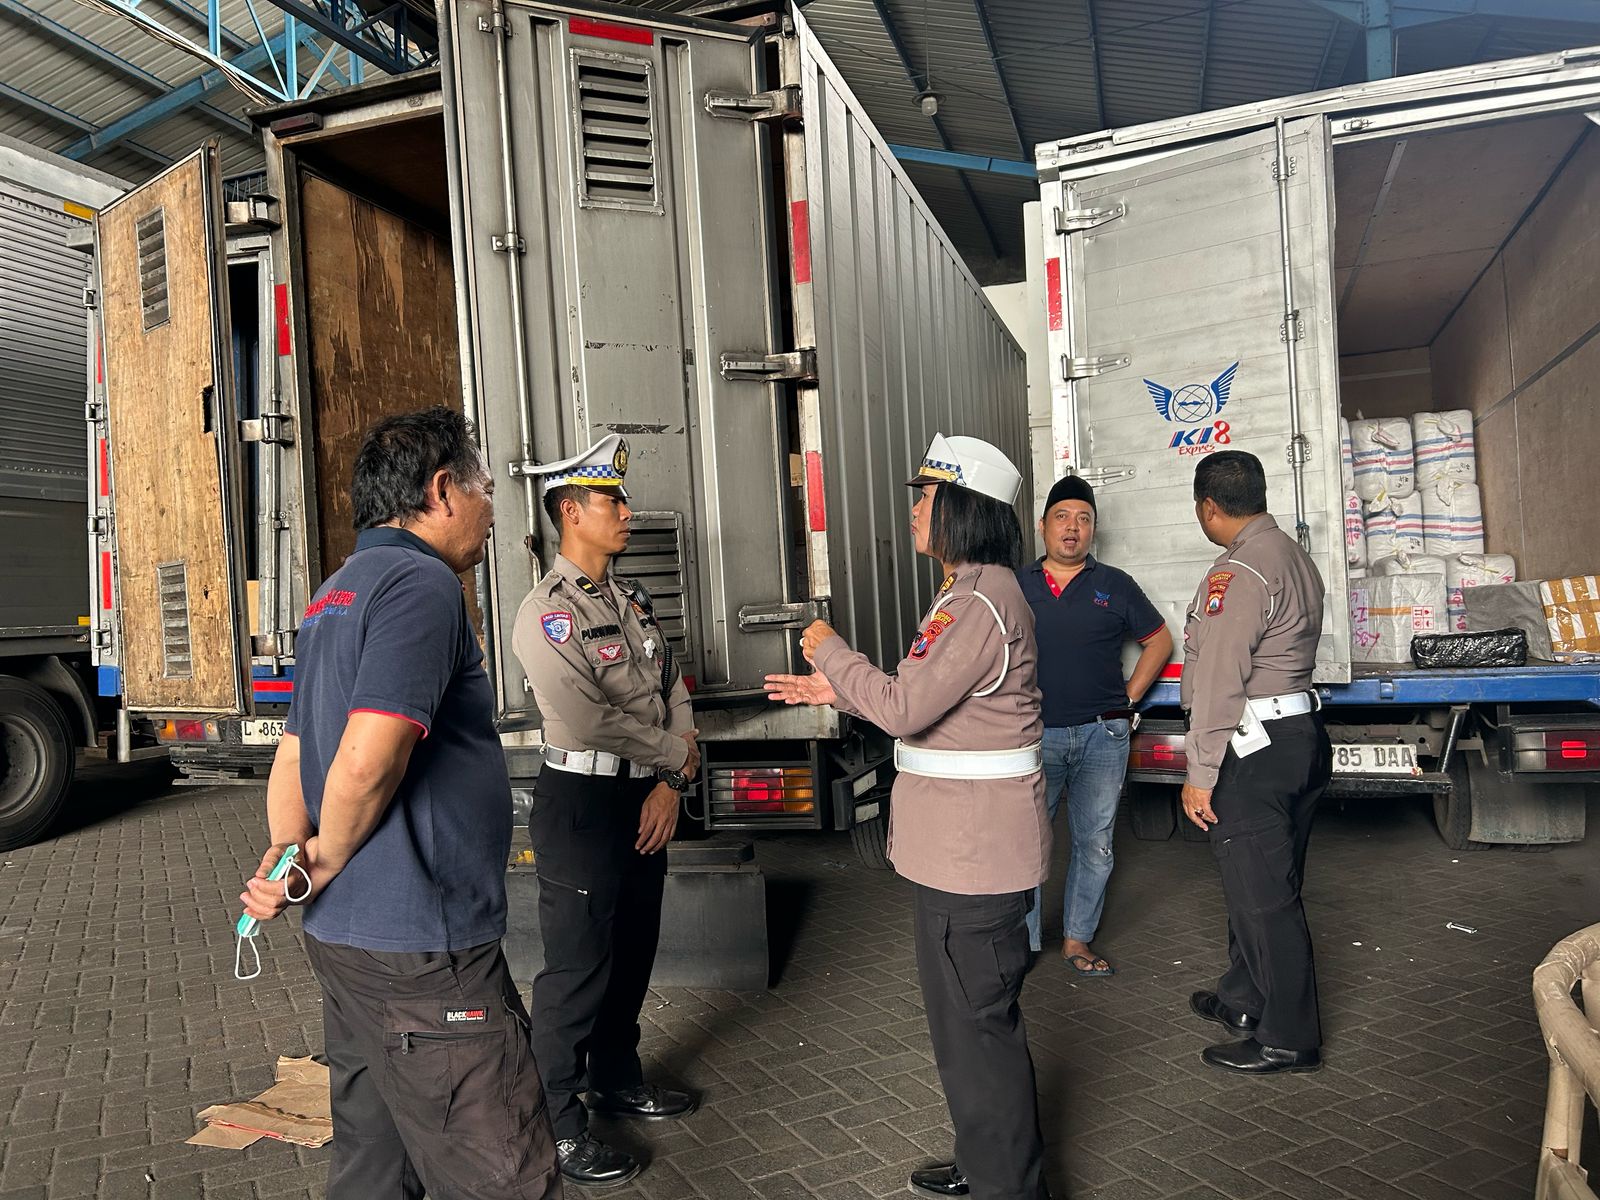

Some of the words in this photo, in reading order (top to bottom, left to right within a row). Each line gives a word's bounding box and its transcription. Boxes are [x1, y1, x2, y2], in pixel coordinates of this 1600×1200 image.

[1168, 420, 1231, 448] KI8
[1178, 443, 1216, 456] Expres
[244, 721, 252, 736] L
[262, 721, 286, 737] 863
[1332, 746, 1361, 767] 85
[1374, 747, 1413, 767] DAA
[446, 1010, 484, 1018] BLACKHAWK
